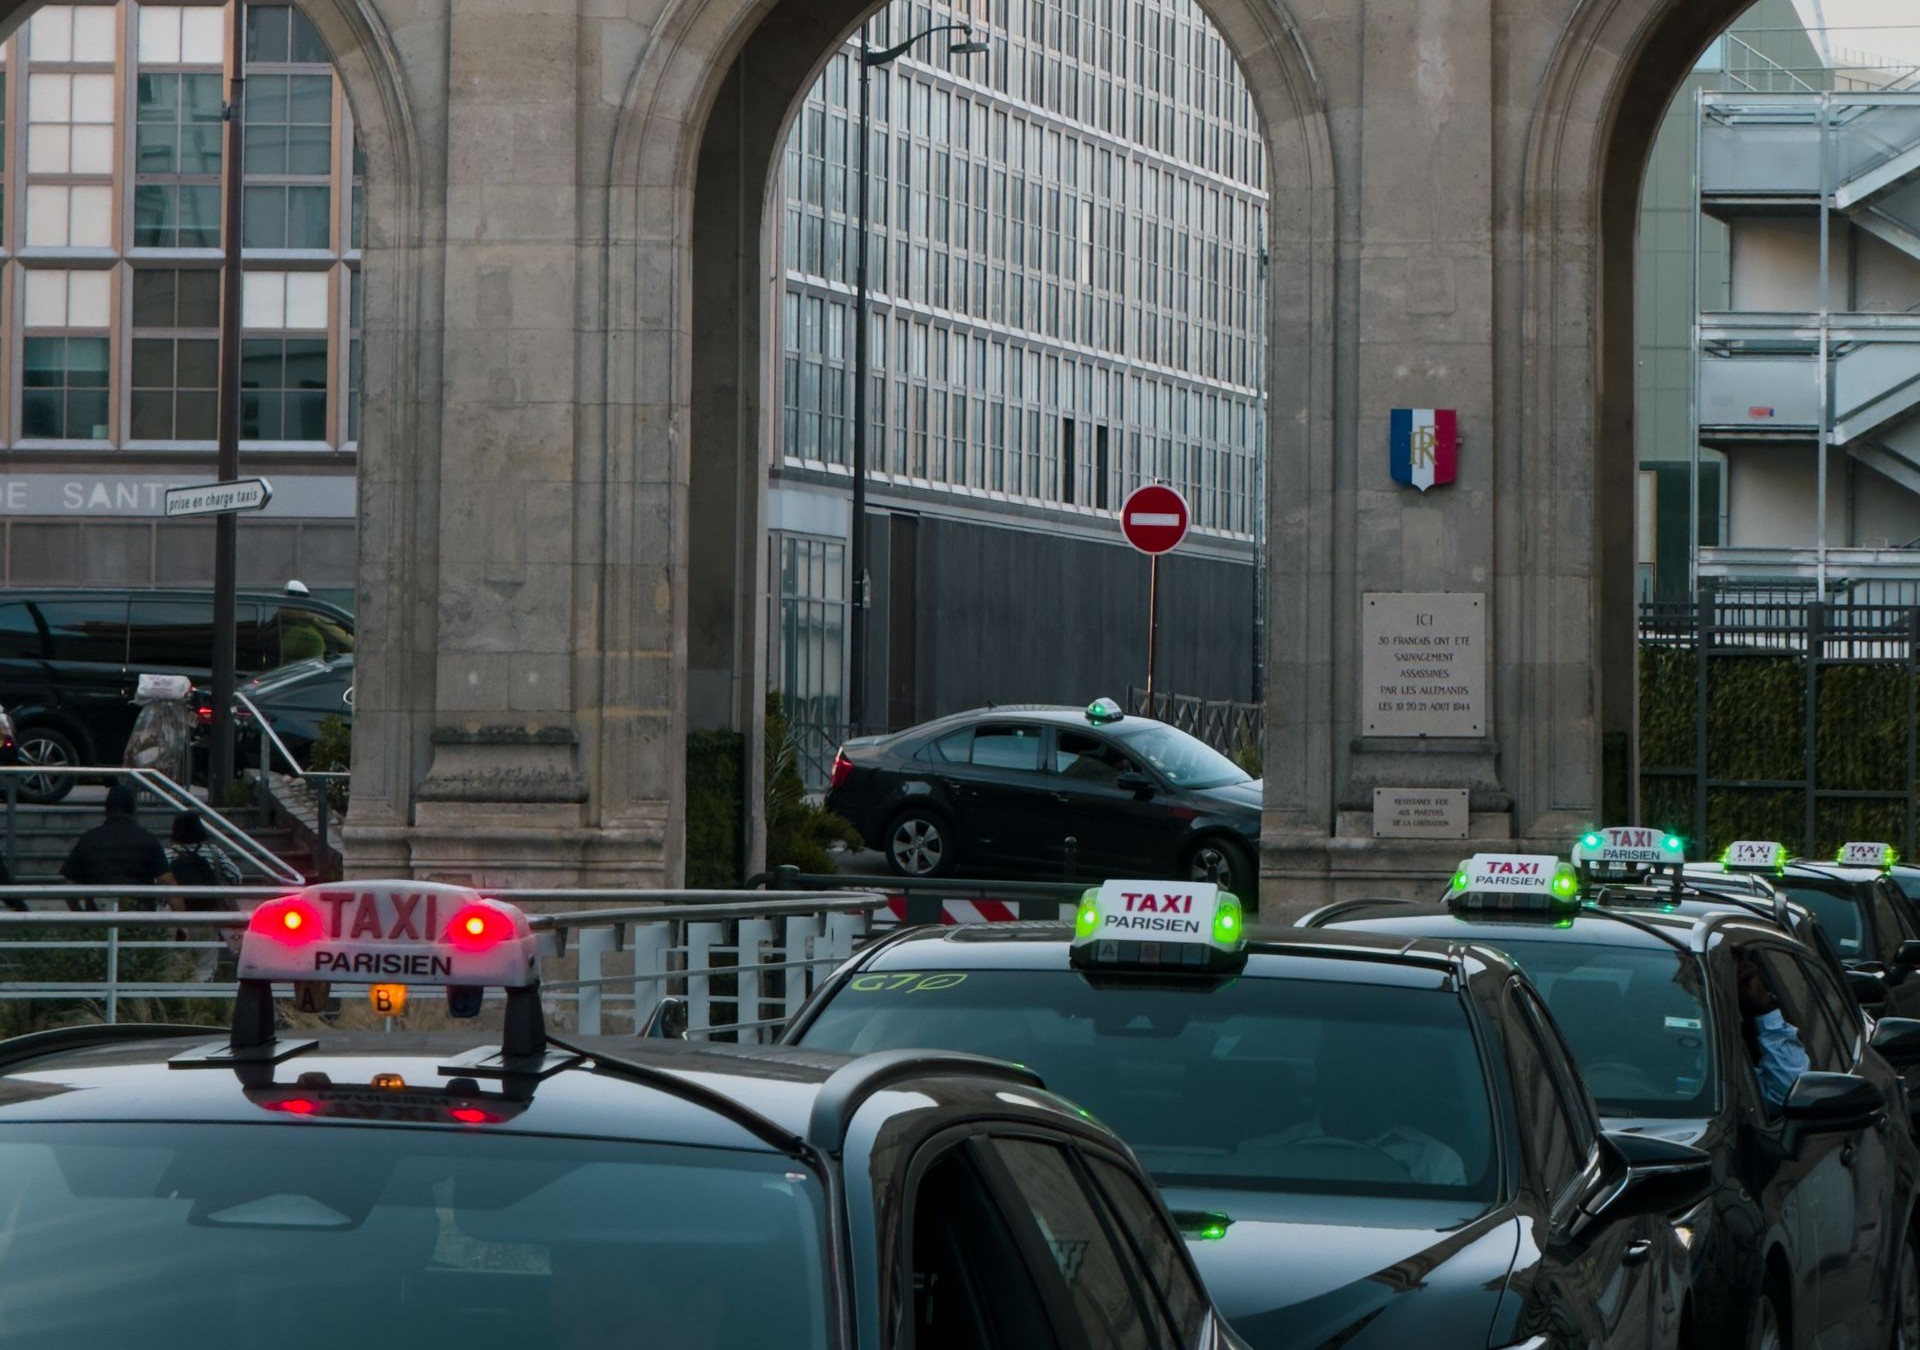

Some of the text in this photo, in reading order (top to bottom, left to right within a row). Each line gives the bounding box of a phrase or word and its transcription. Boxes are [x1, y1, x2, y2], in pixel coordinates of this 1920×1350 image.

[0, 481, 187, 509] E SANT
[169, 487, 258, 513] prise en charge taxis
[1416, 613, 1433, 626] ICI
[1434, 635, 1449, 646] ONT
[1394, 652, 1454, 663] SAUVAGEMENT
[1380, 685, 1469, 695] PAR LES ALLEMANDS
[1378, 701, 1393, 711] LES
[1452, 701, 1470, 711] 1944
[1608, 830, 1652, 847] TAXI
[1603, 848, 1661, 860] PARISIEN
[1736, 844, 1771, 853] TAXI
[1849, 845, 1881, 853] TAXI
[1486, 861, 1540, 875] TAXI
[1475, 875, 1546, 886] PARISIEN
[1121, 892, 1193, 914] TAXI
[319, 892, 439, 941] TAXI
[1104, 914, 1200, 934] PARISIEN
[314, 951, 452, 977] PARISIEN
[850, 973, 922, 991] G7
[300, 986, 316, 1012] A
[376, 989, 392, 1012] B
